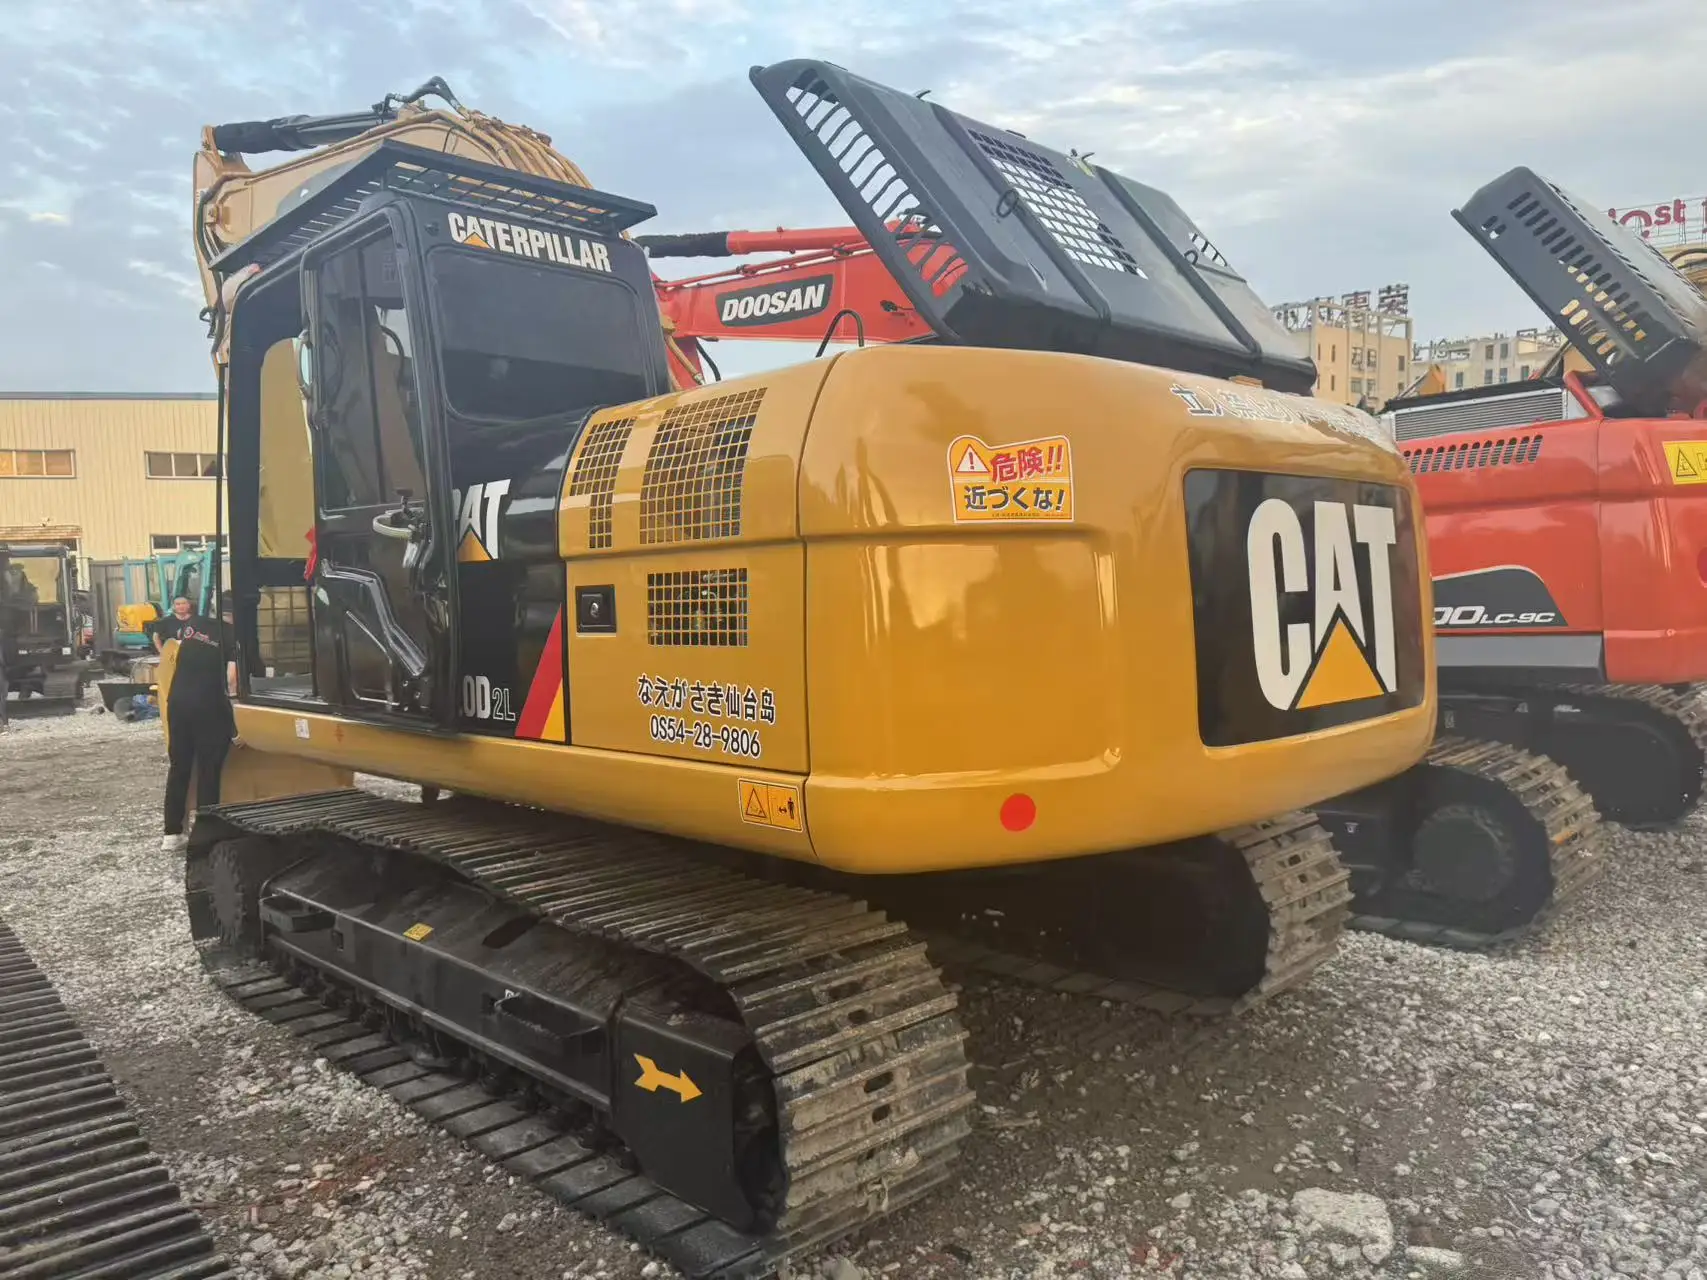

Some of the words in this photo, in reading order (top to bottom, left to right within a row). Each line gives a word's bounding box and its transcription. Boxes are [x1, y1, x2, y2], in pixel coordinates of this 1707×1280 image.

[447, 212, 612, 273] CATERPILLAR
[722, 283, 825, 321] DOOSAN
[990, 444, 1063, 483] 危険!!
[452, 478, 511, 561] AT
[964, 484, 1065, 512] 近づくな!
[1247, 498, 1398, 711] CAT
[461, 675, 516, 722] 0D2L
